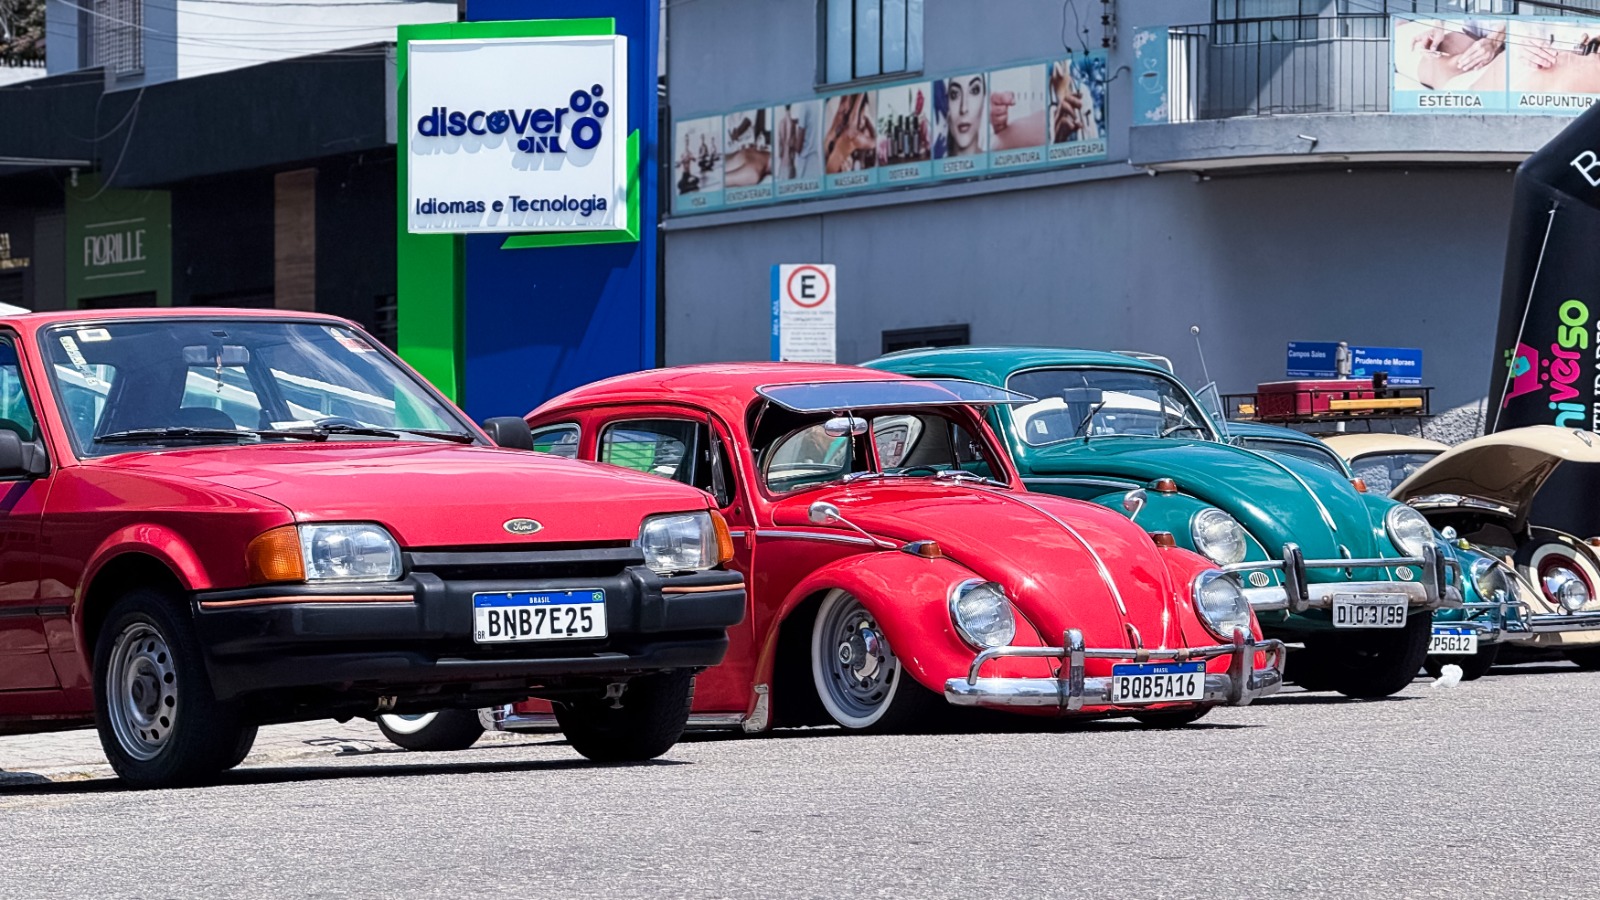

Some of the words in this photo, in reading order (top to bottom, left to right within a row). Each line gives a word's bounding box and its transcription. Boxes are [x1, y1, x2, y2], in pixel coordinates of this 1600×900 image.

[1419, 92, 1482, 107] ESTÉTICA
[417, 107, 569, 137] discover
[994, 151, 1041, 166] ACUPUNTURA
[416, 198, 486, 215] Idiomas
[492, 200, 504, 213] e
[509, 194, 607, 217] Tecnologia
[84, 229, 146, 266] FIORILLE
[801, 275, 816, 298] E
[1288, 350, 1310, 358] Campos
[1355, 357, 1382, 365] Prudente
[1392, 358, 1415, 366] Moraes
[513, 520, 533, 531] Ford
[529, 596, 551, 604] BRASIL
[488, 606, 593, 638] BNB7E25
[477, 630, 486, 640] BR
[1120, 674, 1195, 699] BQB5A16
